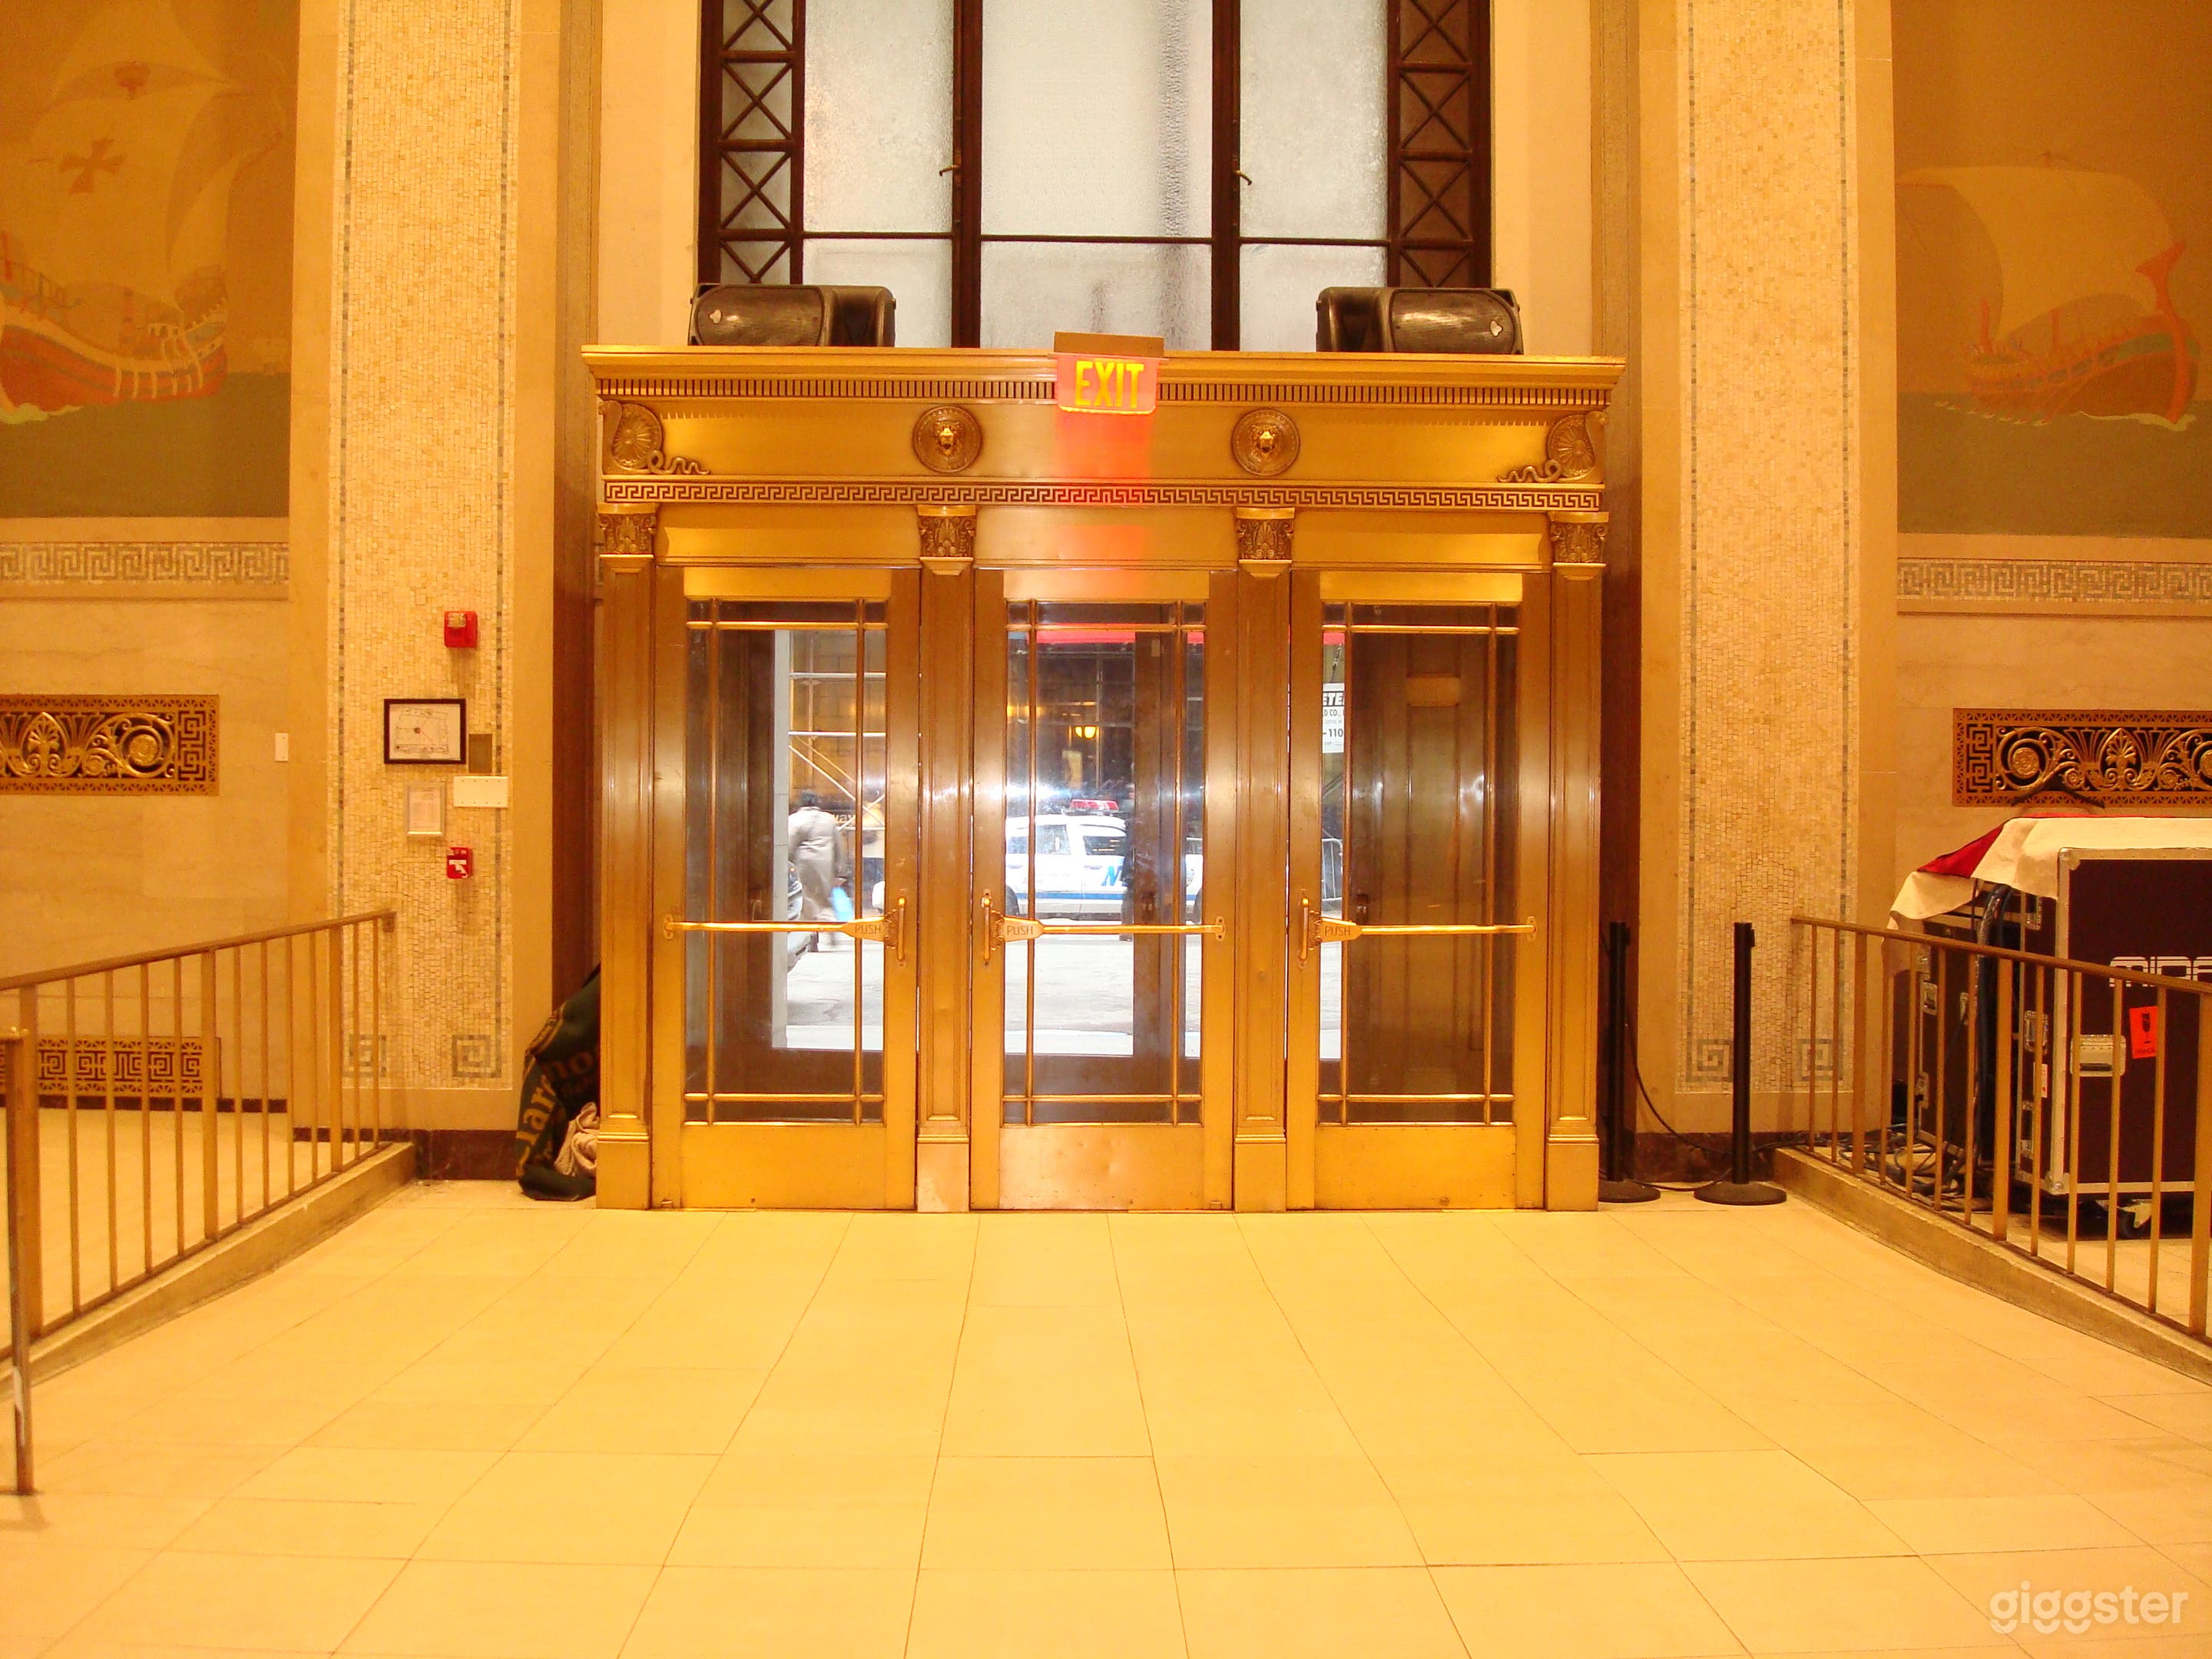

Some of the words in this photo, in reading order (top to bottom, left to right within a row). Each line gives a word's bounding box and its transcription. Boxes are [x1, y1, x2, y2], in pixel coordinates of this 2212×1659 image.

[1075, 360, 1144, 409] EXIT
[854, 924, 882, 935] PUSH
[1006, 926, 1034, 935] PUSH
[1324, 926, 1351, 936] PUSH
